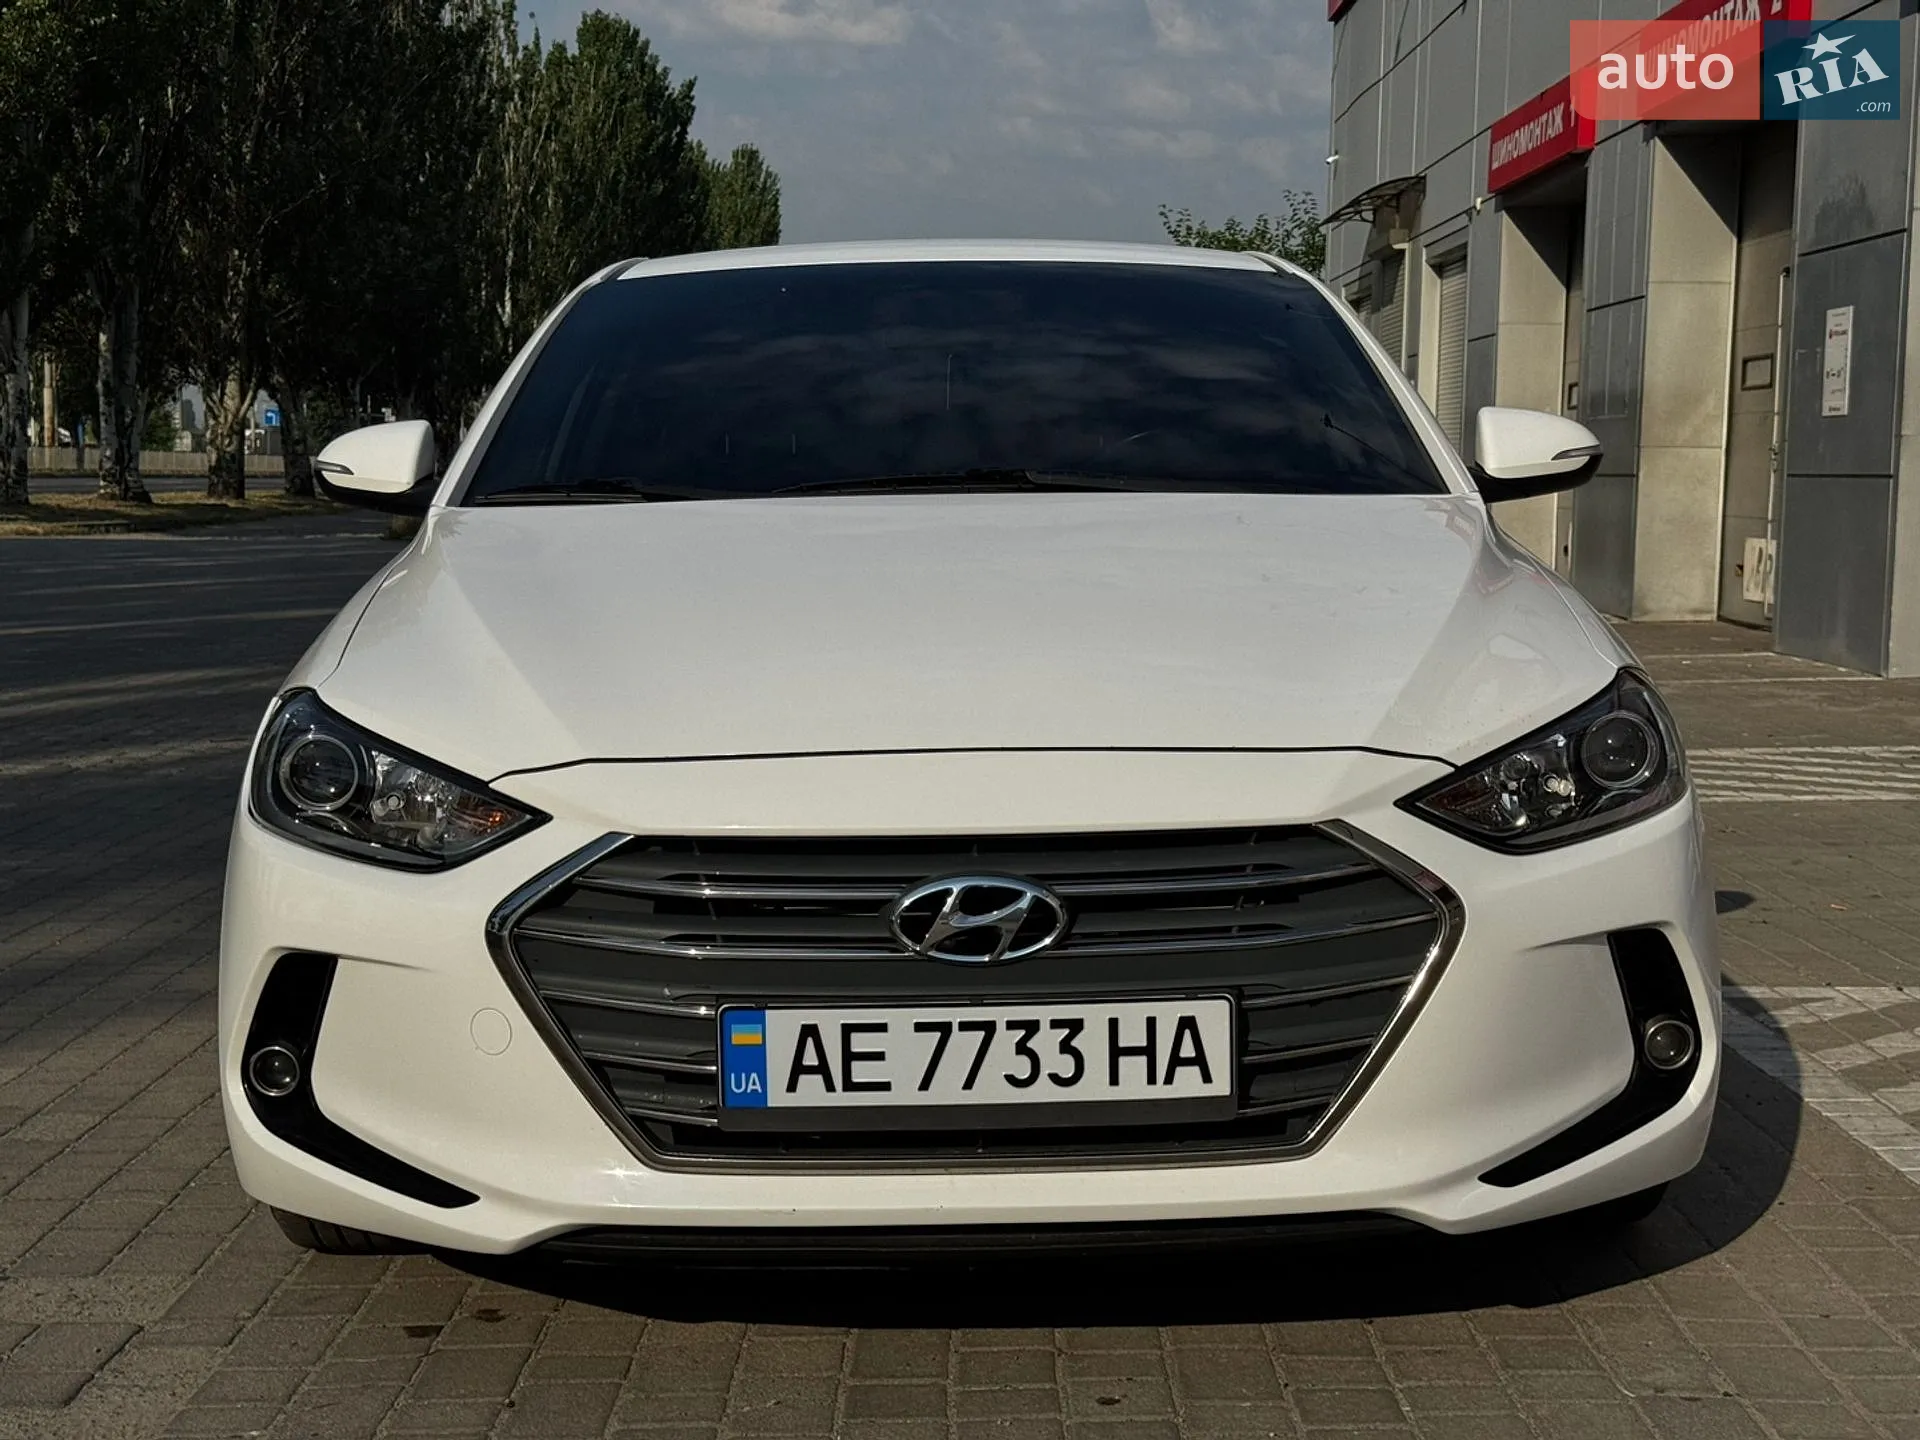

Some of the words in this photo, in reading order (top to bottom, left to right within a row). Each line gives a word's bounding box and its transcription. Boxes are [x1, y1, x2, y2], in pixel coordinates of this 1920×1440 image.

[1492, 102, 1564, 170] ШИНОМОНТАЖ
[731, 1073, 762, 1093] UA
[786, 1022, 892, 1093] AE
[913, 1017, 1085, 1091] 7733
[1107, 1014, 1213, 1087] HA
